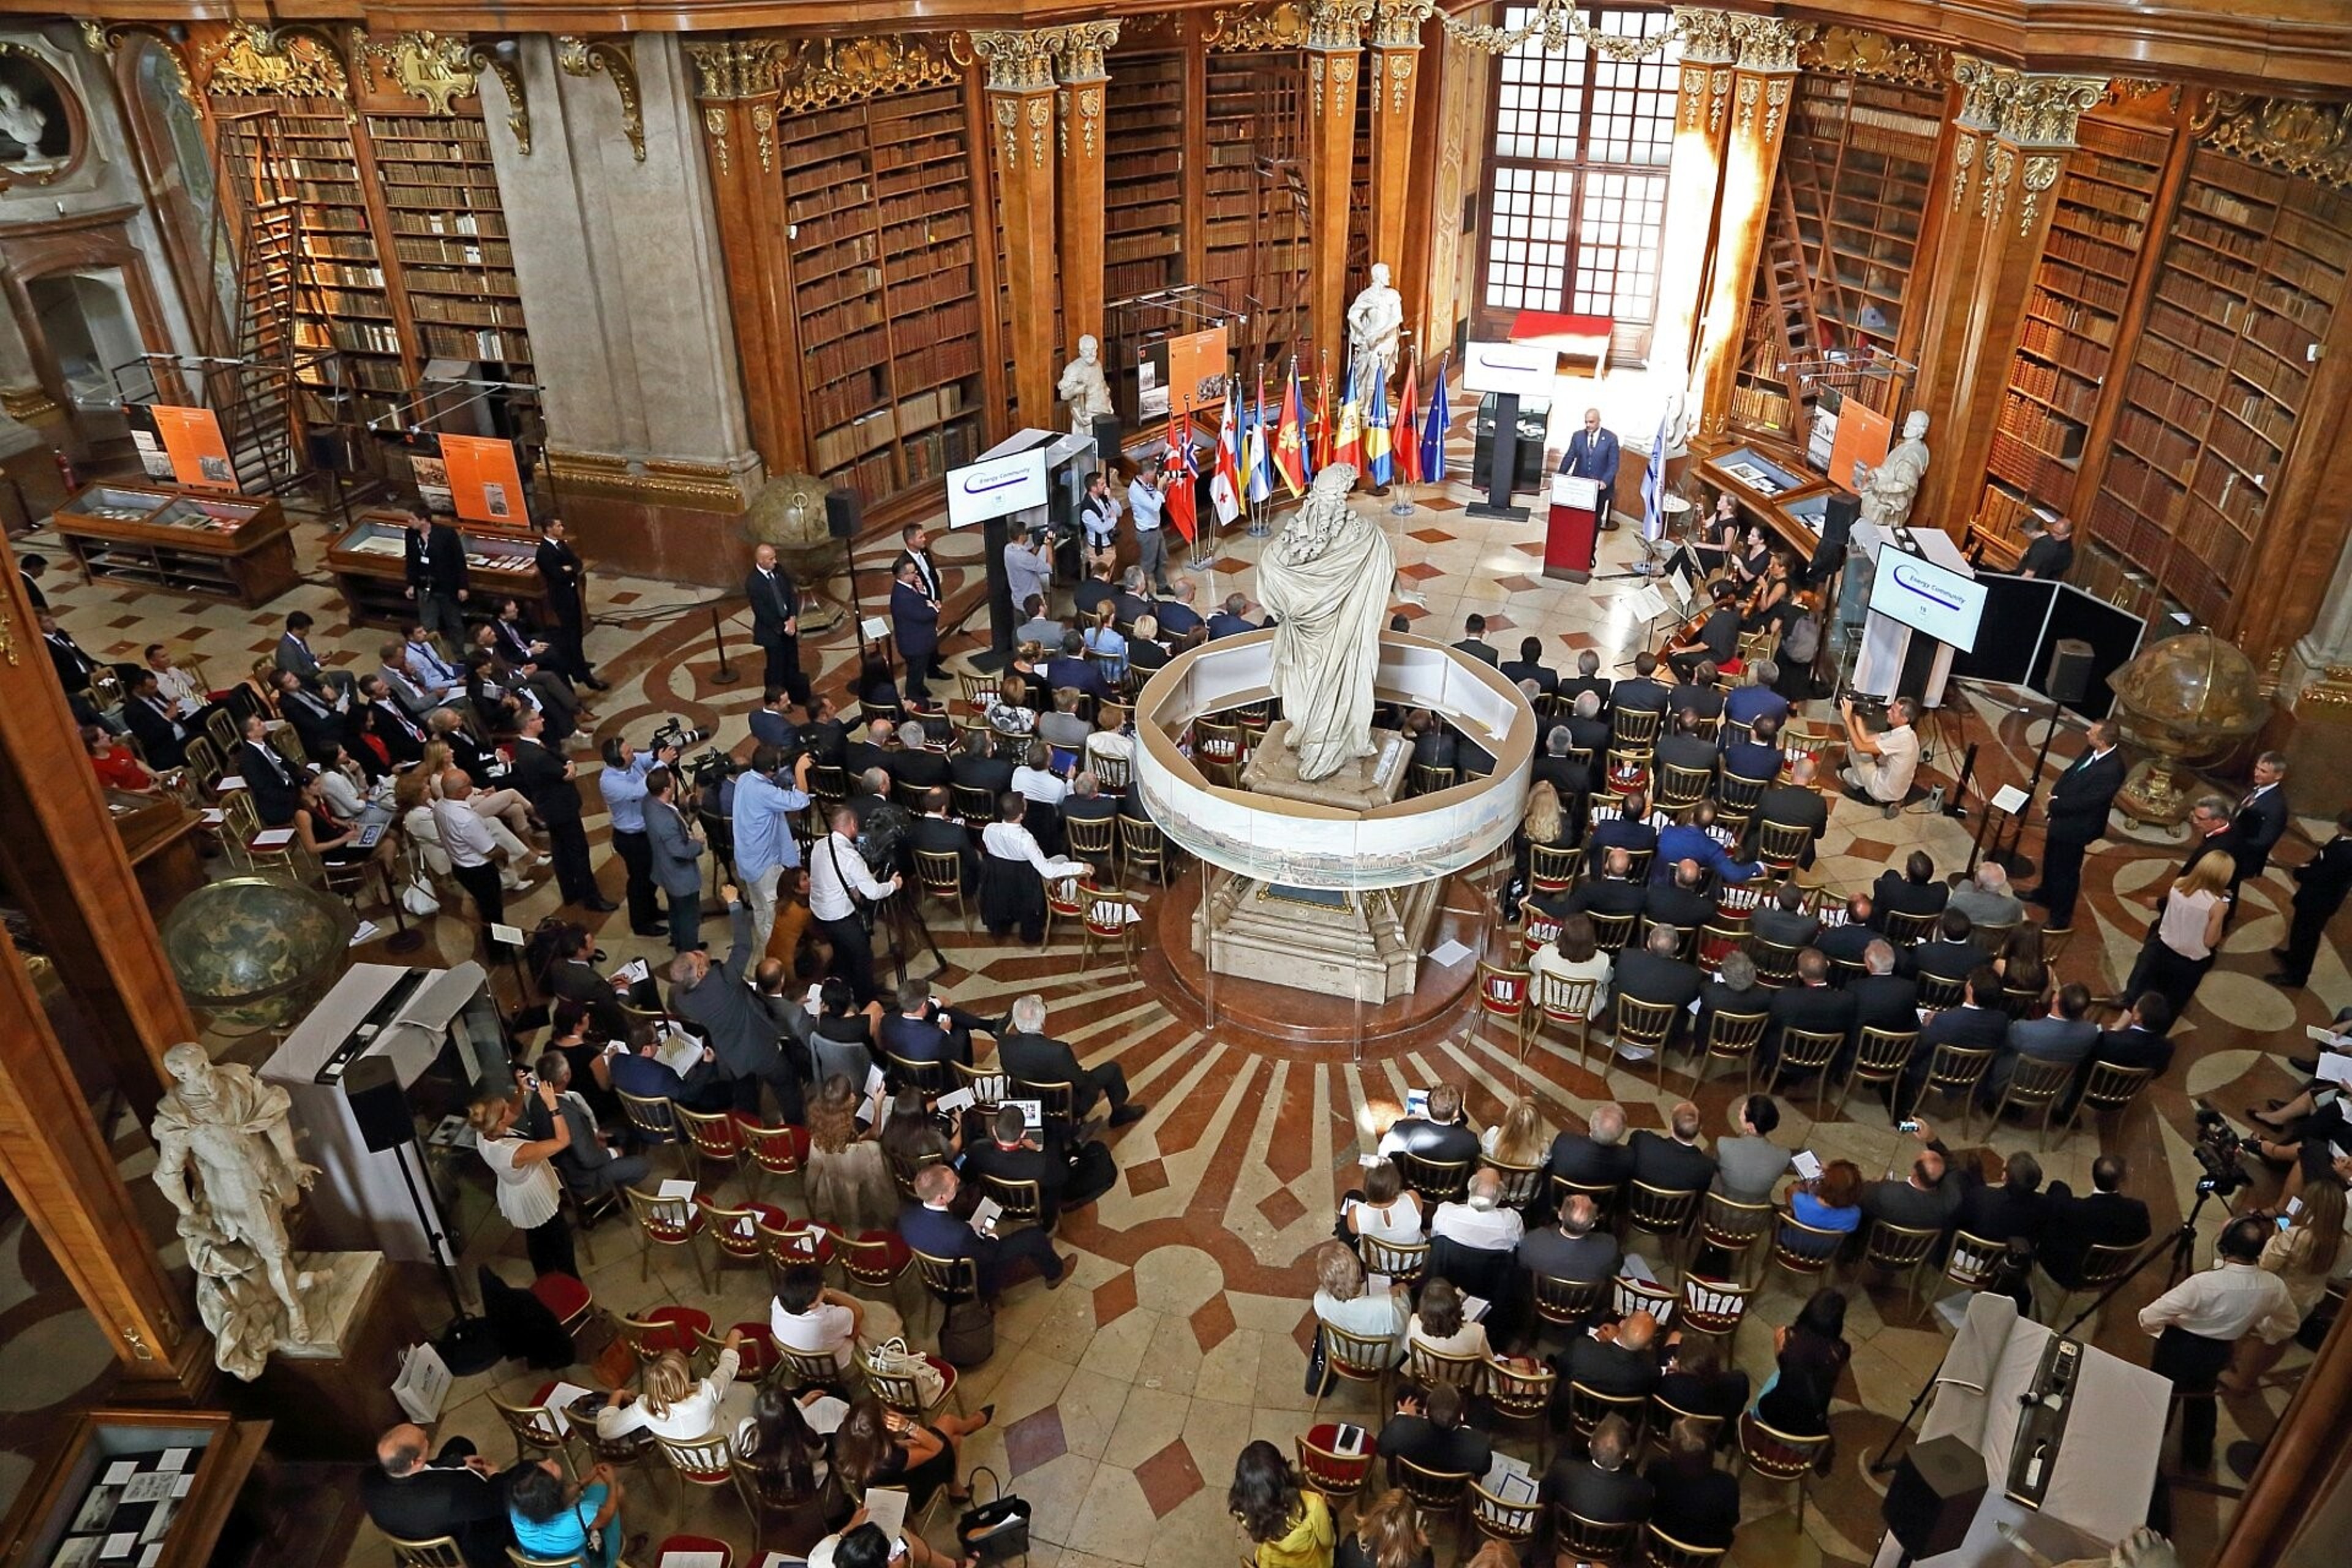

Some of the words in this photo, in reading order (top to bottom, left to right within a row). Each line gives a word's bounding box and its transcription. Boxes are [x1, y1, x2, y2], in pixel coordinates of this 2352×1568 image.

[417, 64, 453, 80] LXIX
[979, 476, 998, 484] Energy
[1000, 467, 1030, 480] Community
[1909, 575, 1930, 589] Energy
[1931, 584, 1966, 604] Community
